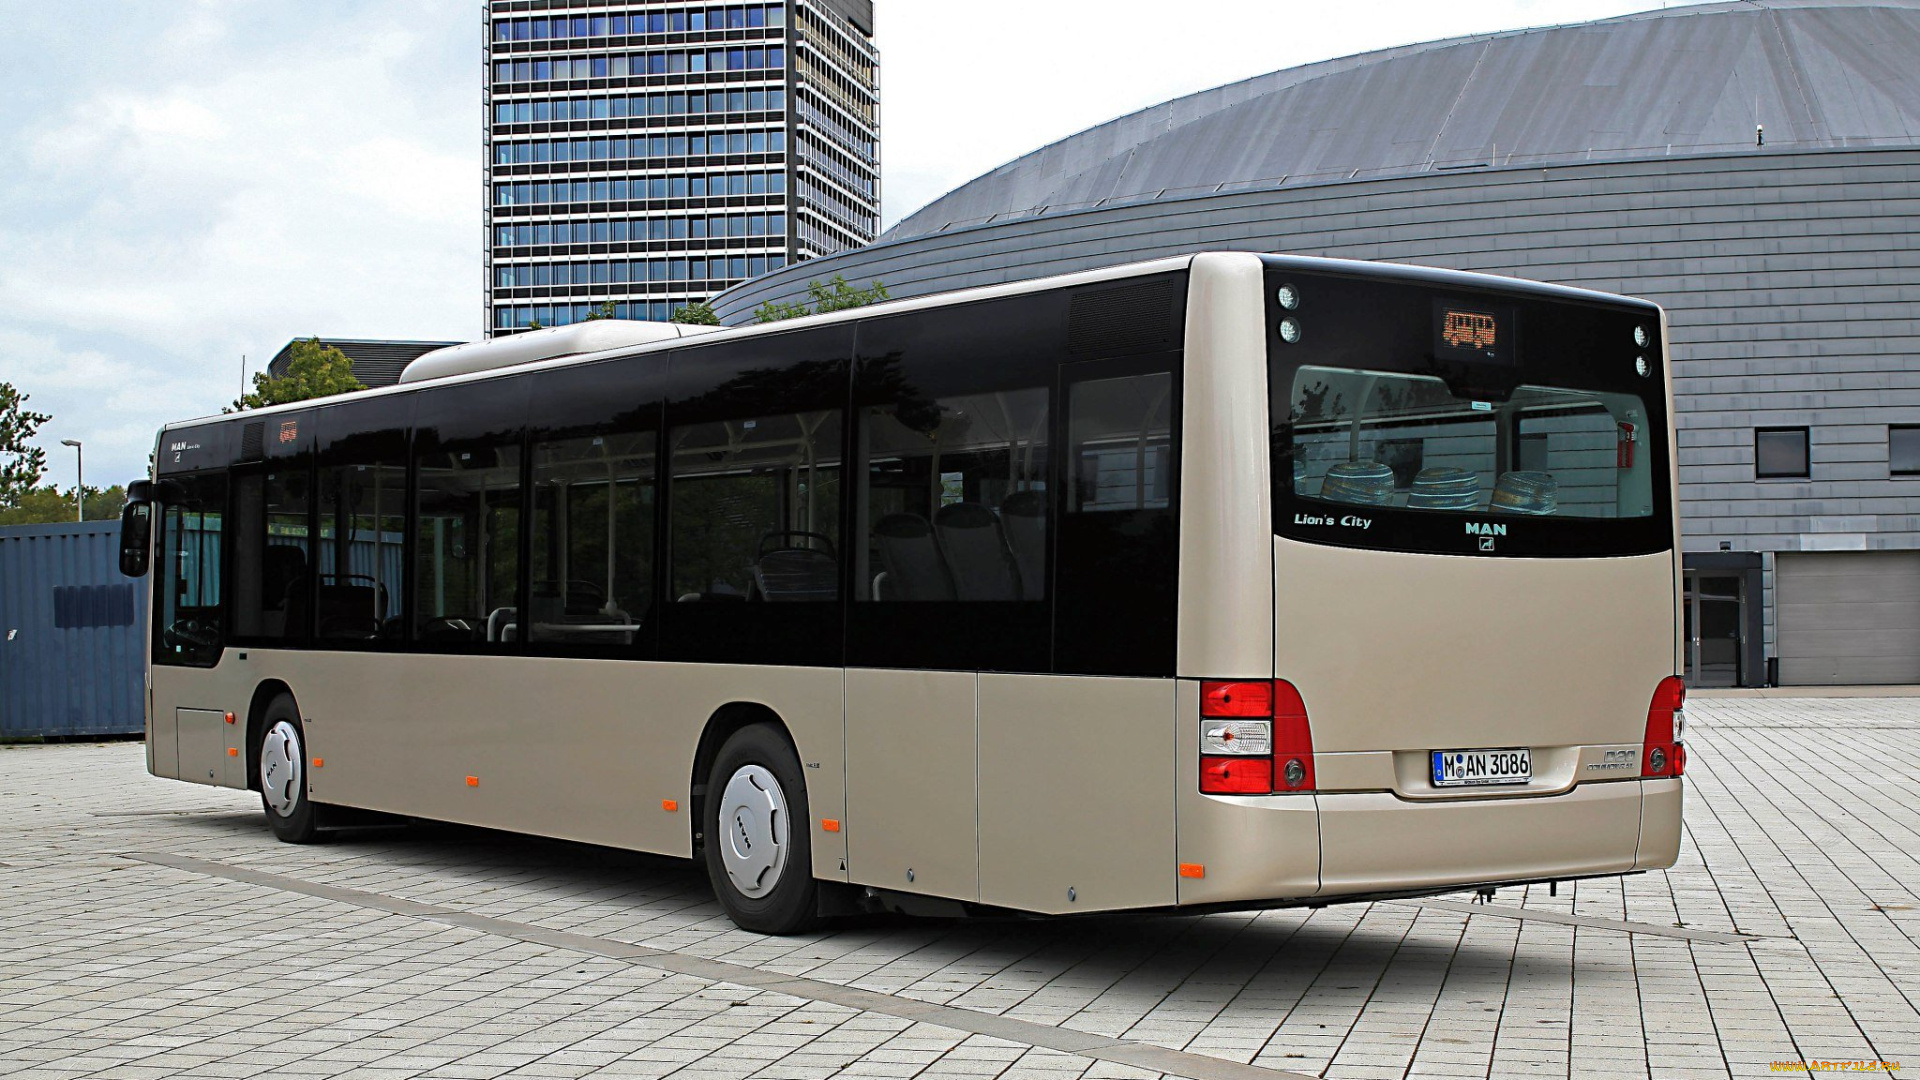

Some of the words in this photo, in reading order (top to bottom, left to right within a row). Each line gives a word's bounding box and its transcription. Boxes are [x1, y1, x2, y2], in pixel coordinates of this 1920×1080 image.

[171, 441, 187, 451] MAN
[1294, 513, 1334, 526] Lion's
[1340, 515, 1372, 529] City
[1465, 522, 1507, 536] MAN
[1490, 753, 1529, 775] 3086
